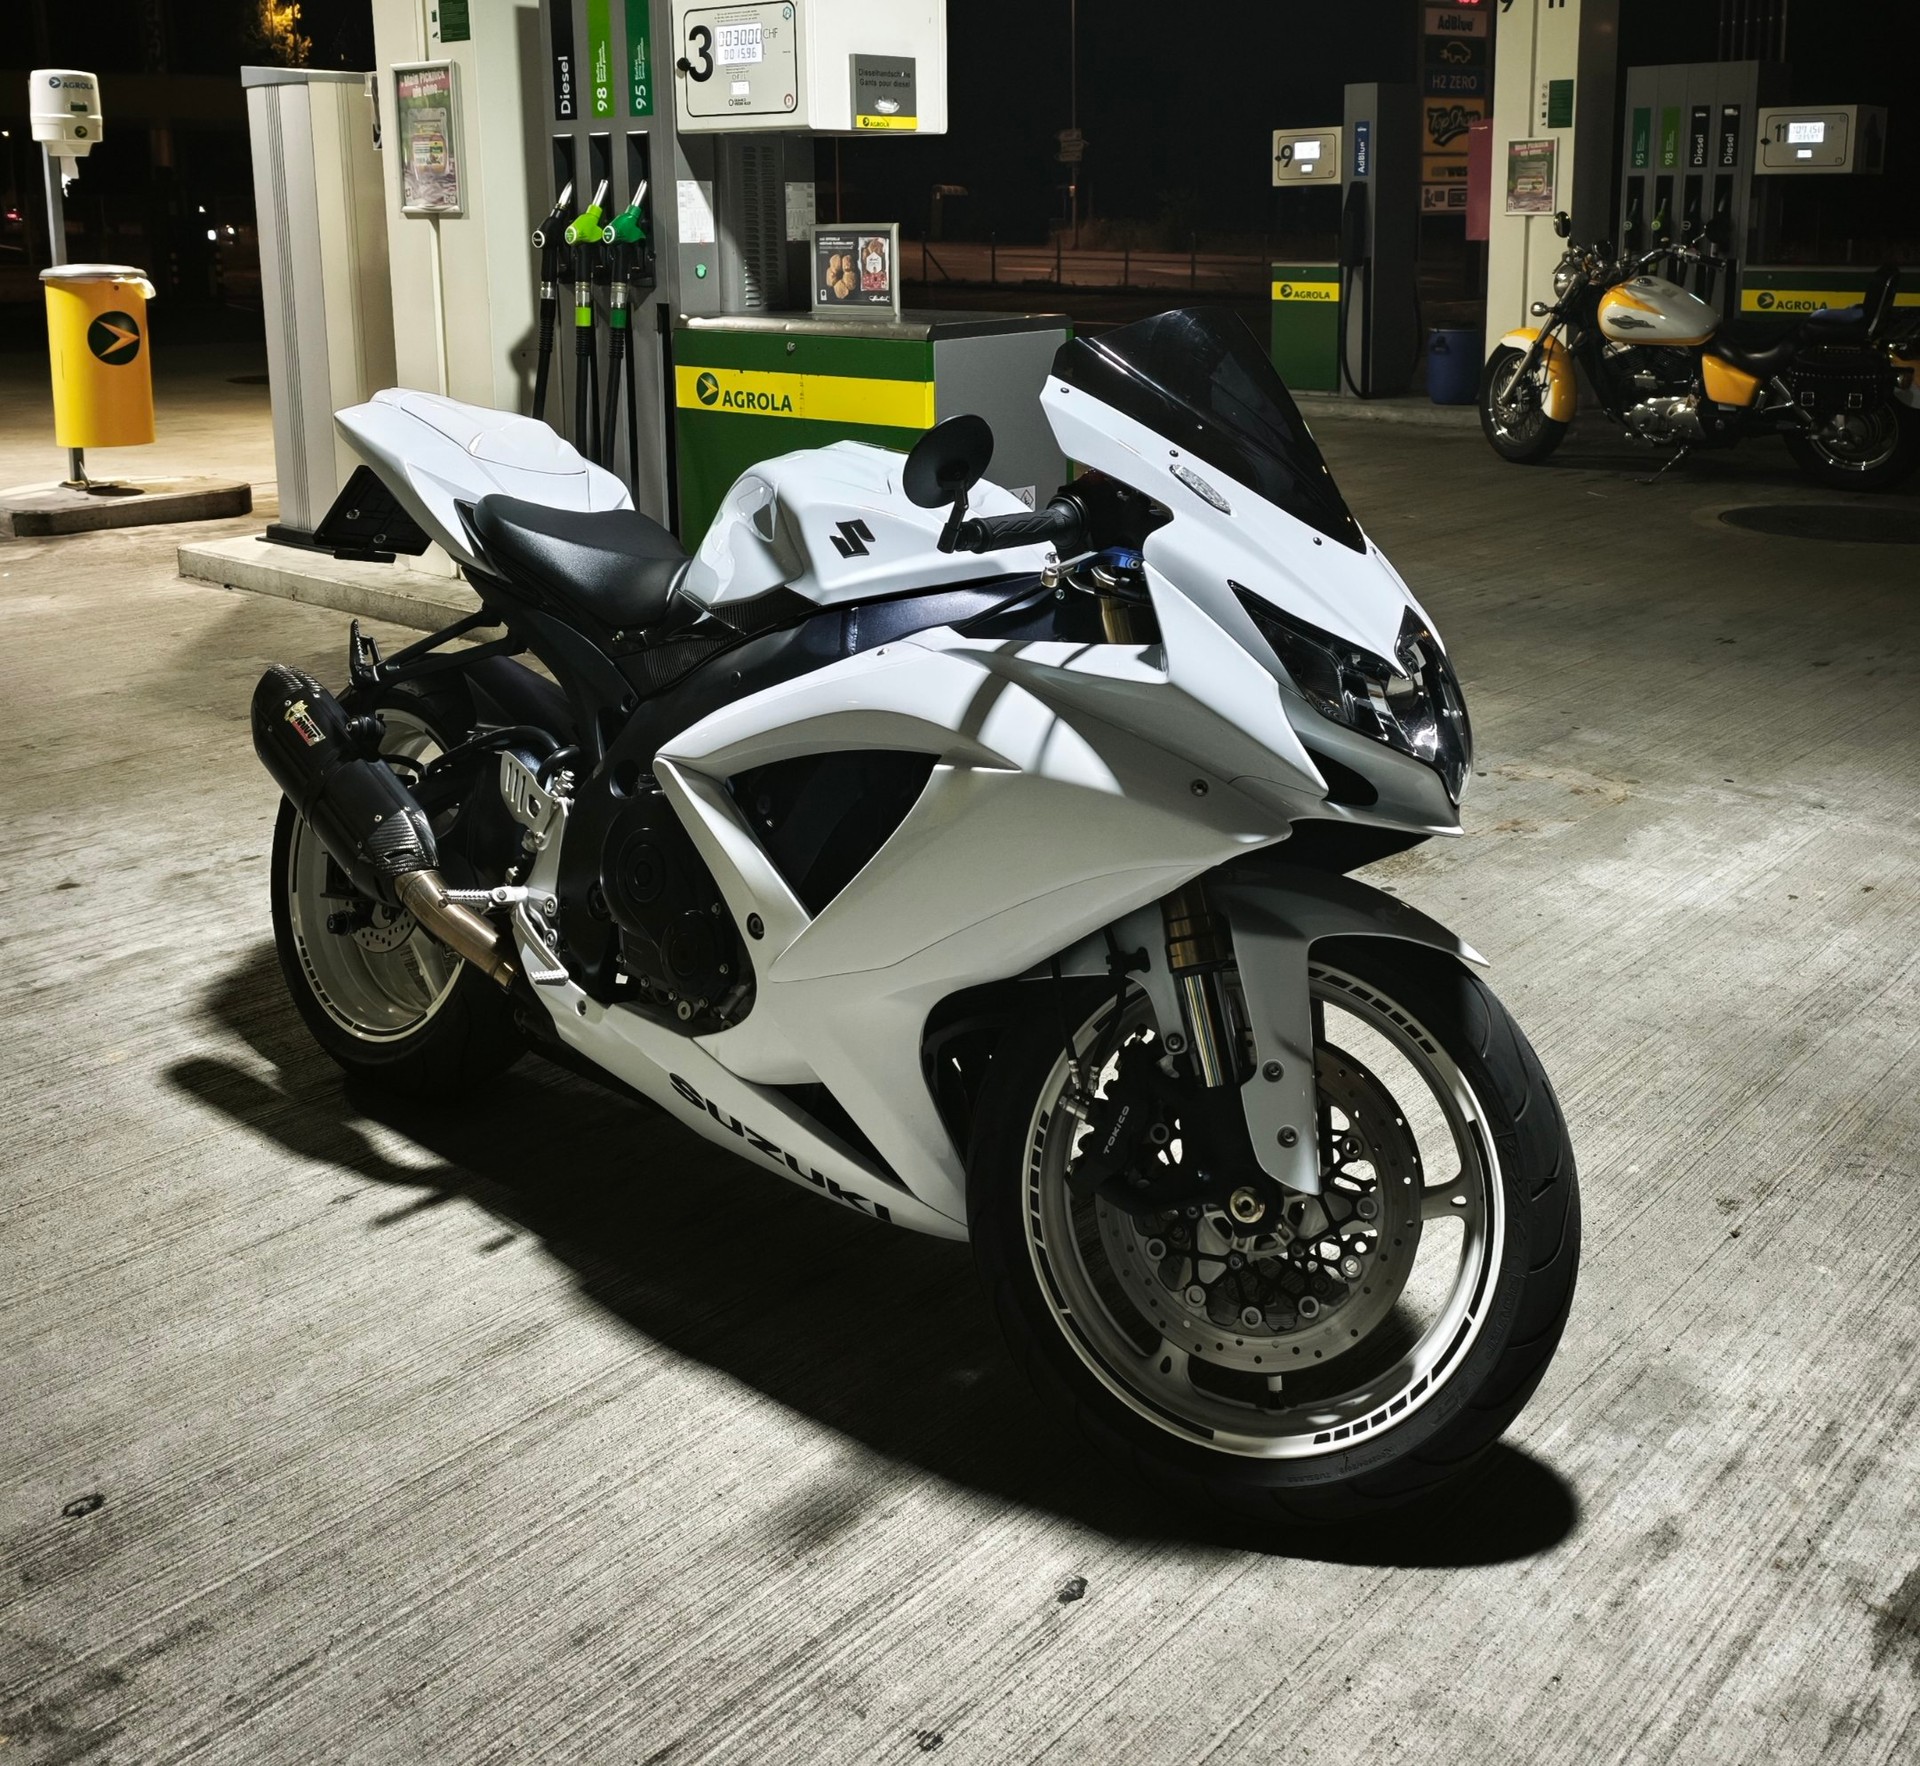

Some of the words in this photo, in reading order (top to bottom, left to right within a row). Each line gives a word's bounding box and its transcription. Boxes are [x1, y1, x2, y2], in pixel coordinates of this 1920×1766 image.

[689, 25, 713, 82] 3
[557, 56, 571, 114] Diesel
[1432, 74, 1447, 89] H2
[1449, 75, 1477, 90] ZERO
[596, 87, 608, 112] 98
[635, 85, 647, 109] 95
[1281, 144, 1293, 167] 9
[1636, 153, 1644, 166] 95
[1665, 153, 1674, 165] 98
[1694, 134, 1704, 165] Diesel
[1724, 133, 1734, 164] Diesel
[1293, 291, 1331, 299] AGROLA
[1776, 300, 1828, 311] AGROLA
[722, 390, 792, 412] AGROLA
[1103, 1105, 1130, 1154] TOKICO
[669, 1072, 893, 1223] SUZUKI
